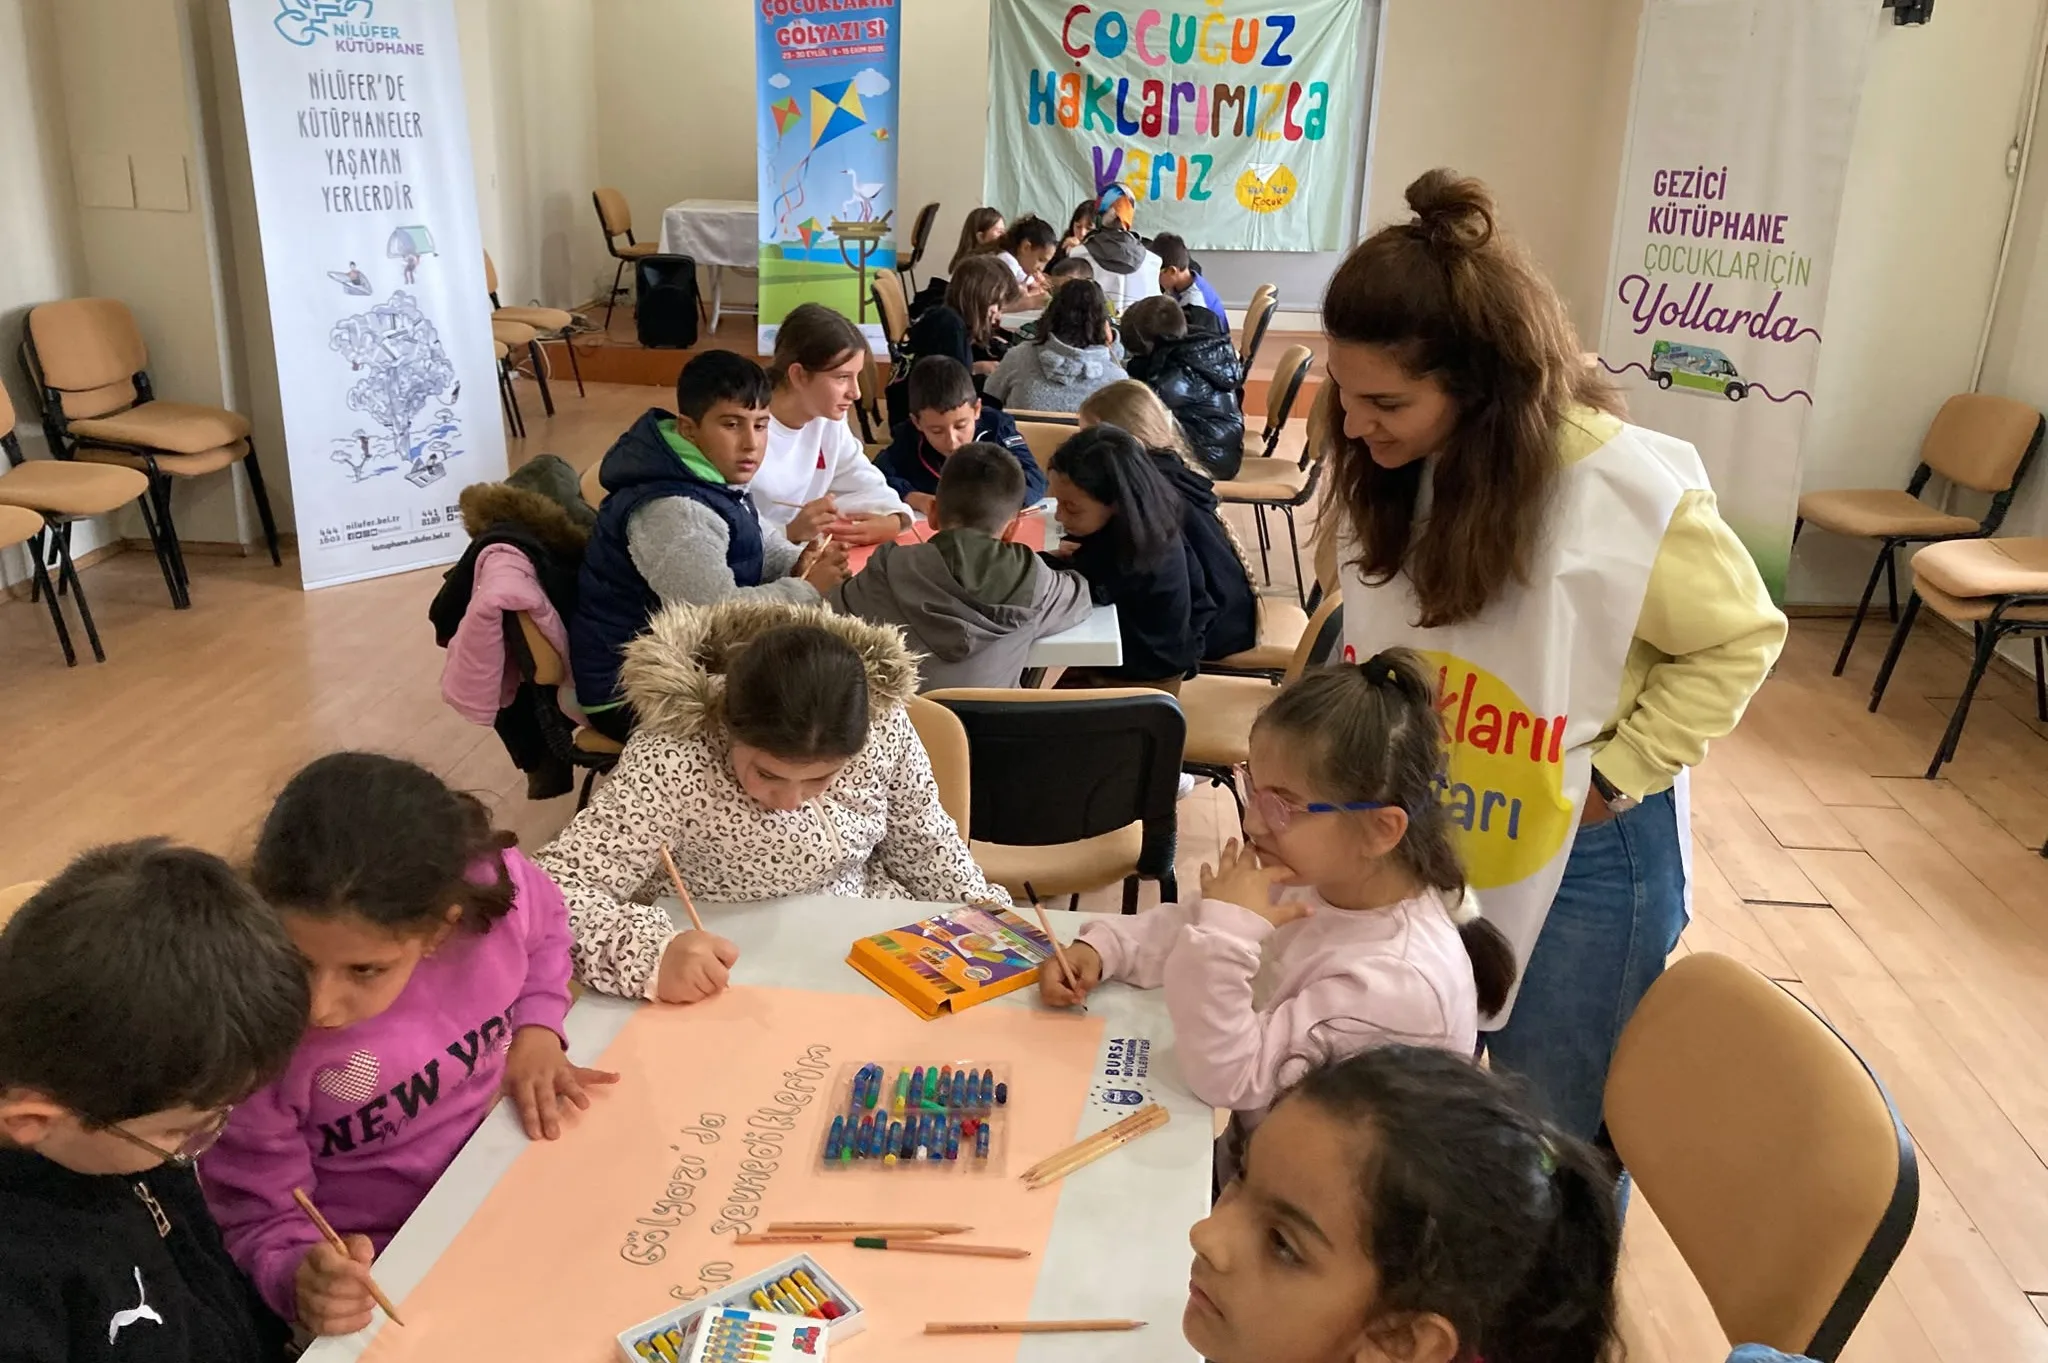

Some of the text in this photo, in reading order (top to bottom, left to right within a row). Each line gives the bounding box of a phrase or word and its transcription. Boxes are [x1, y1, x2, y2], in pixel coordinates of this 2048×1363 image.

[333, 22, 400, 39] NİLÜFER
[336, 38, 425, 56] KÜTÜPHANE
[1061, 0, 1296, 68] ÇOCUĞUZ
[308, 69, 407, 102] NİLÜFER'DE
[297, 107, 424, 139] KÜTÜPHANELER
[325, 148, 403, 180] YAŞAYAN
[322, 181, 414, 213] YERLERDİR
[1653, 165, 1728, 201] GEZİCİ
[1648, 202, 1789, 244] KÜTÜPHANE
[1644, 243, 1812, 290] ÇOCUKLAR İÇİN
[1618, 274, 1822, 344] Yollarda
[1105, 1038, 1125, 1076] BURSA
[317, 1058, 440, 1158] NEW
